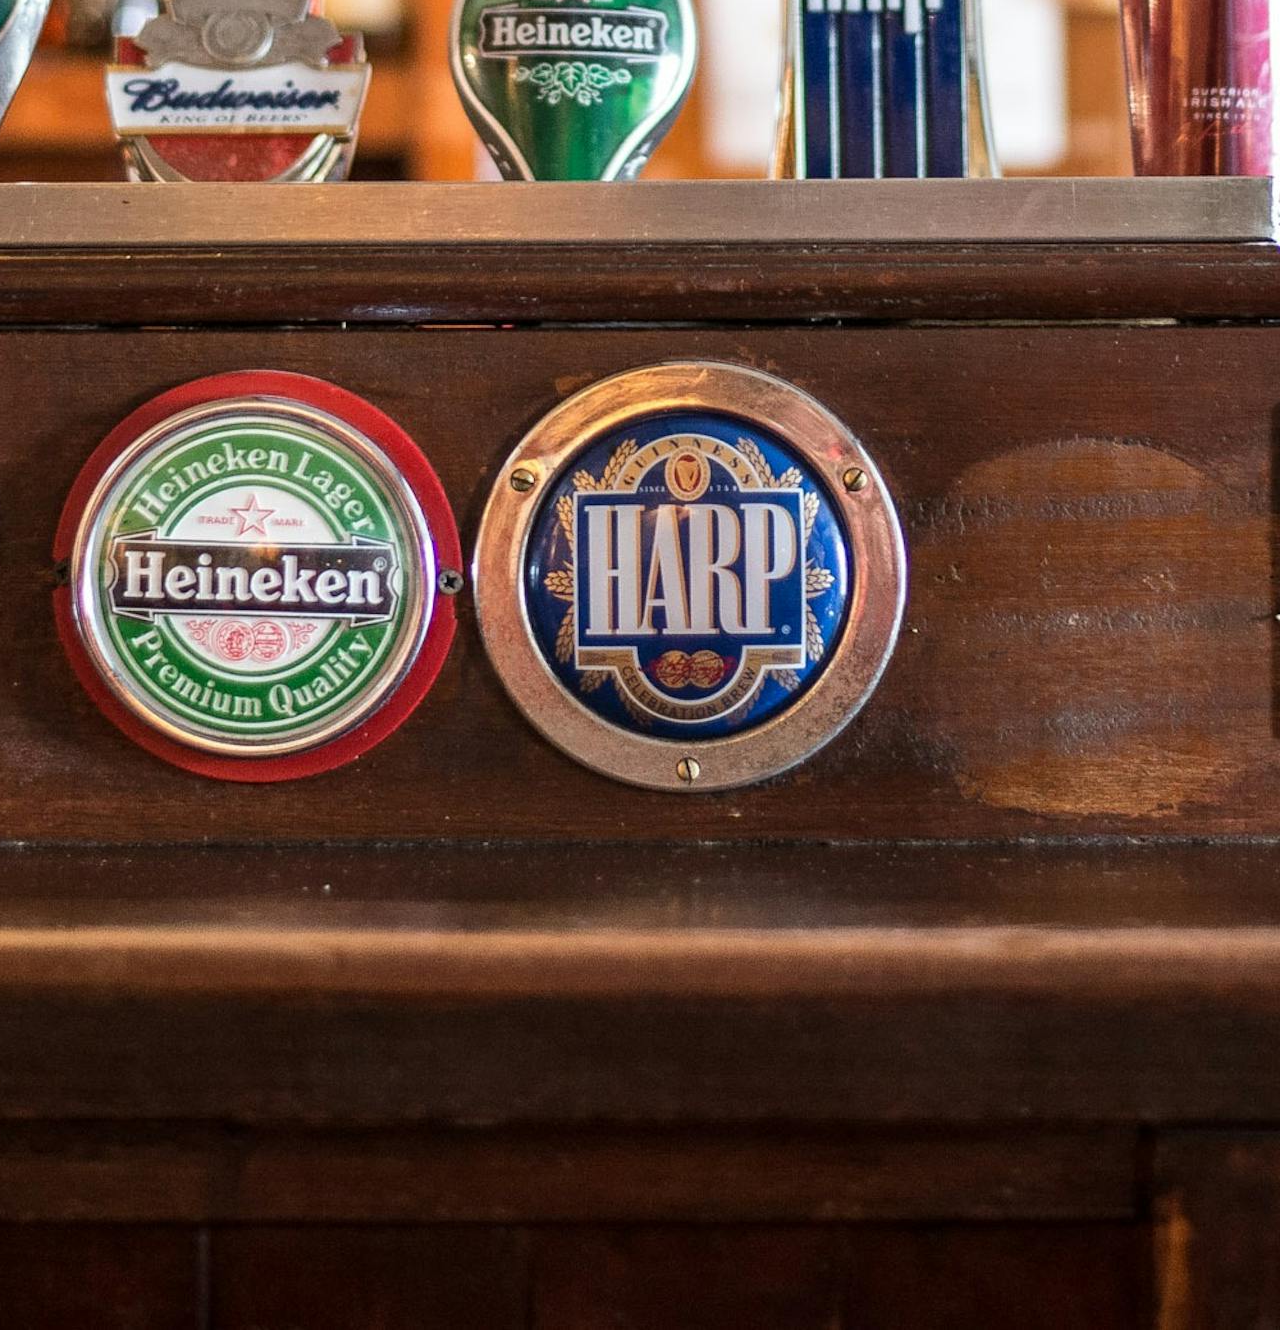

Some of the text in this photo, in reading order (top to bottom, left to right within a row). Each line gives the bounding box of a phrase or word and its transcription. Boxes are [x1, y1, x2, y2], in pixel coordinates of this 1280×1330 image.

[492, 15, 655, 50] Heineken
[123, 77, 341, 112] Budweiser
[1182, 97, 1268, 108] IRISH ALE
[132, 443, 374, 533] Heineken Lager
[623, 436, 754, 486] GUINNESS
[122, 550, 385, 606] Heineken
[584, 502, 798, 637] HARP
[130, 629, 375, 718] Premium Quality
[621, 665, 717, 720] CELEBRATION
[723, 666, 758, 707] BREW
